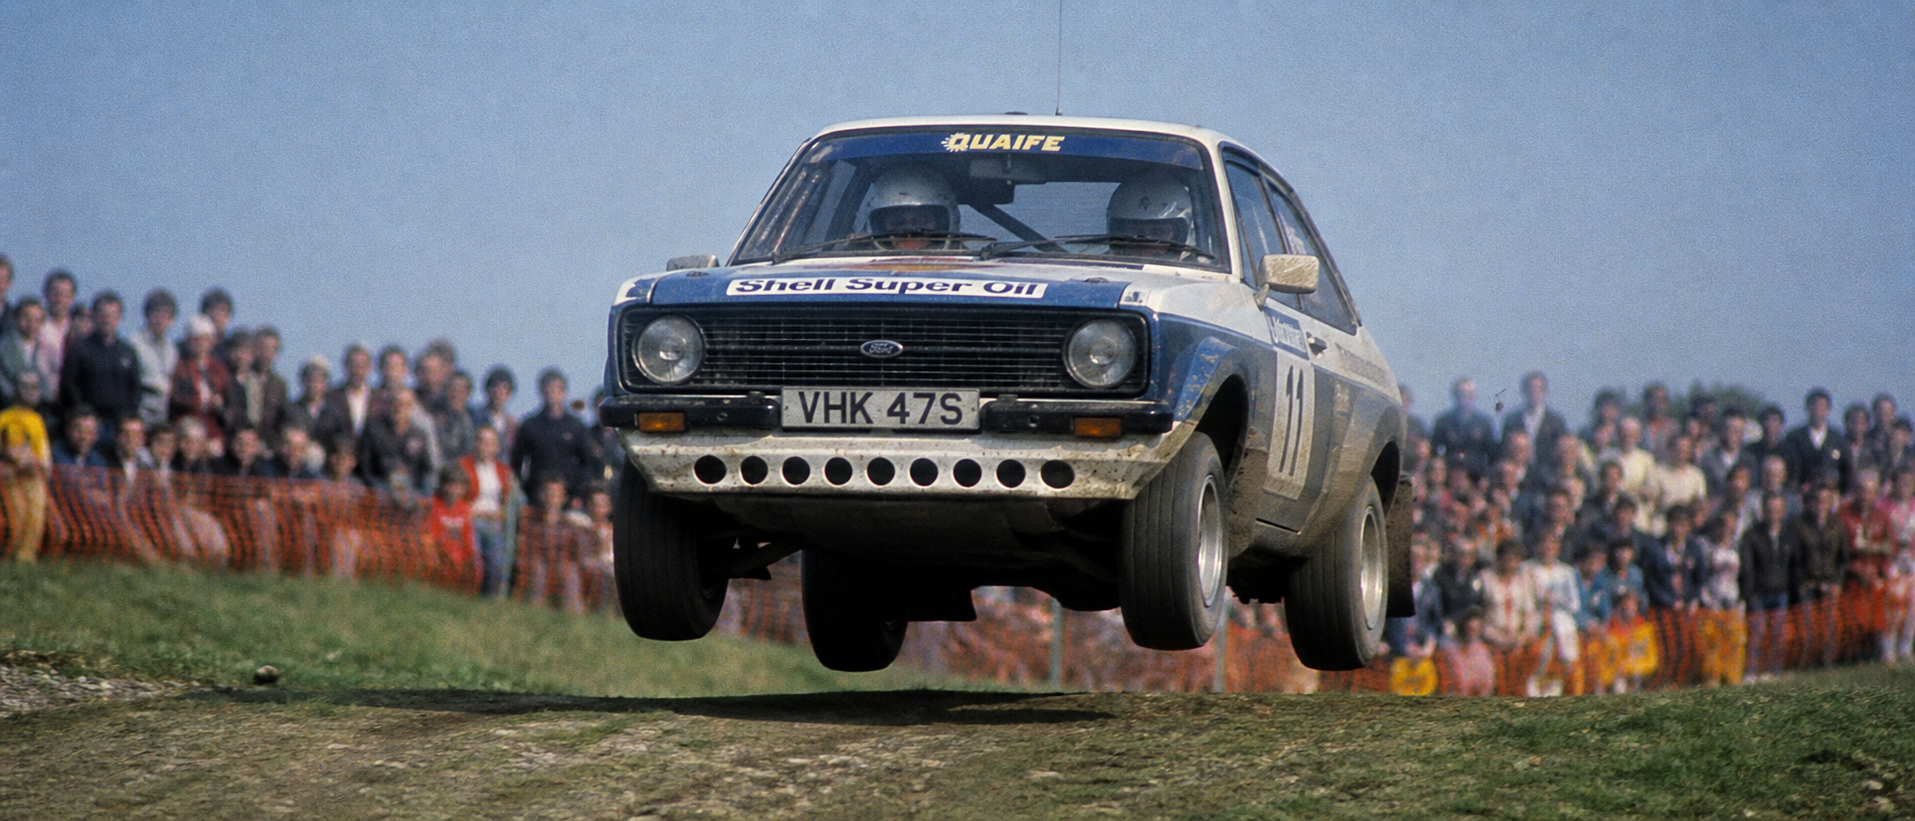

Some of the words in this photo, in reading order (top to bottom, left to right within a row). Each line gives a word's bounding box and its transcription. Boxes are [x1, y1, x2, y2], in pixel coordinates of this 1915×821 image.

[944, 133, 1066, 152] QUAIFE
[736, 279, 836, 292] Shell
[845, 278, 972, 294] Super
[983, 282, 1038, 294] Oil
[798, 391, 874, 424] VHK
[887, 392, 963, 425] 47S
[1278, 364, 1304, 477] 11
